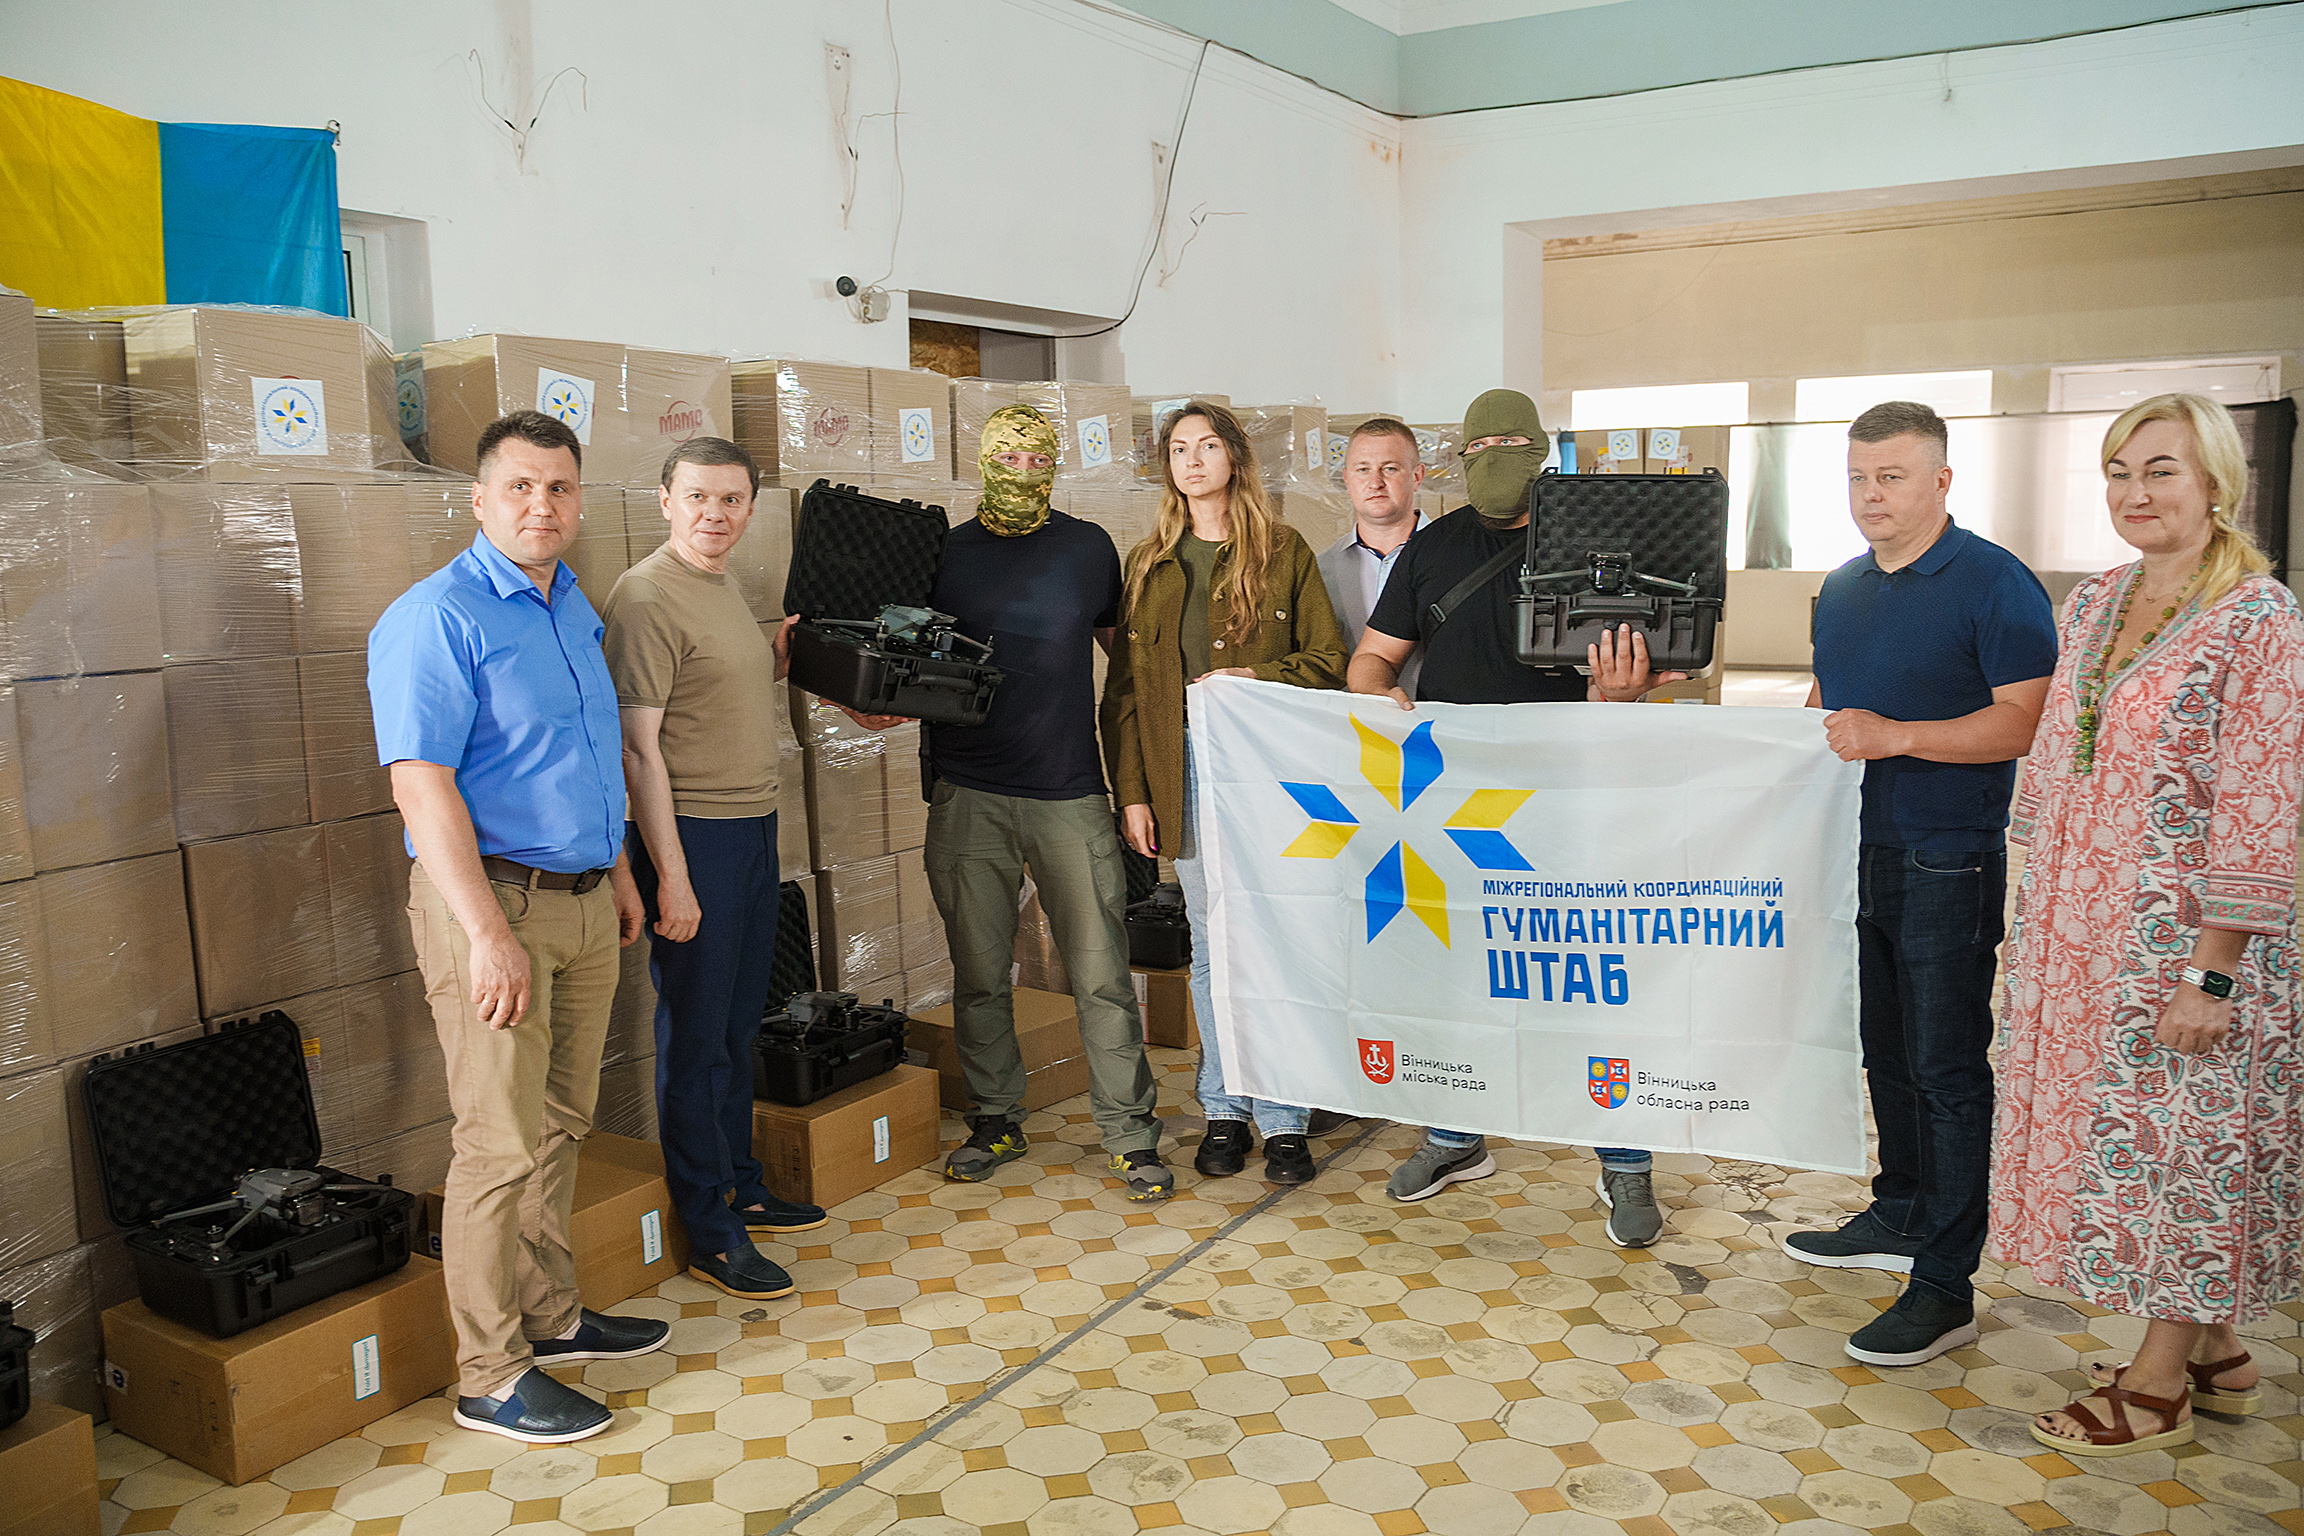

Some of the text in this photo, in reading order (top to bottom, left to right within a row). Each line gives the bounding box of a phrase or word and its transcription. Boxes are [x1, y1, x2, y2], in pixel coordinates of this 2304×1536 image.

[1483, 876, 1783, 898] МІЖРЕГІОНАЛЬНИЙ КООРДИНАЦІЙНИЙ
[1482, 900, 1784, 948] ГУМАНІТАРНИЙ
[1487, 949, 1629, 1006] ШТАБ
[1401, 1054, 1473, 1074] Вінницька
[1402, 1070, 1486, 1091] міська рада
[1638, 1071, 1716, 1092] Вінницька
[1636, 1093, 1750, 1113] обласна рада
